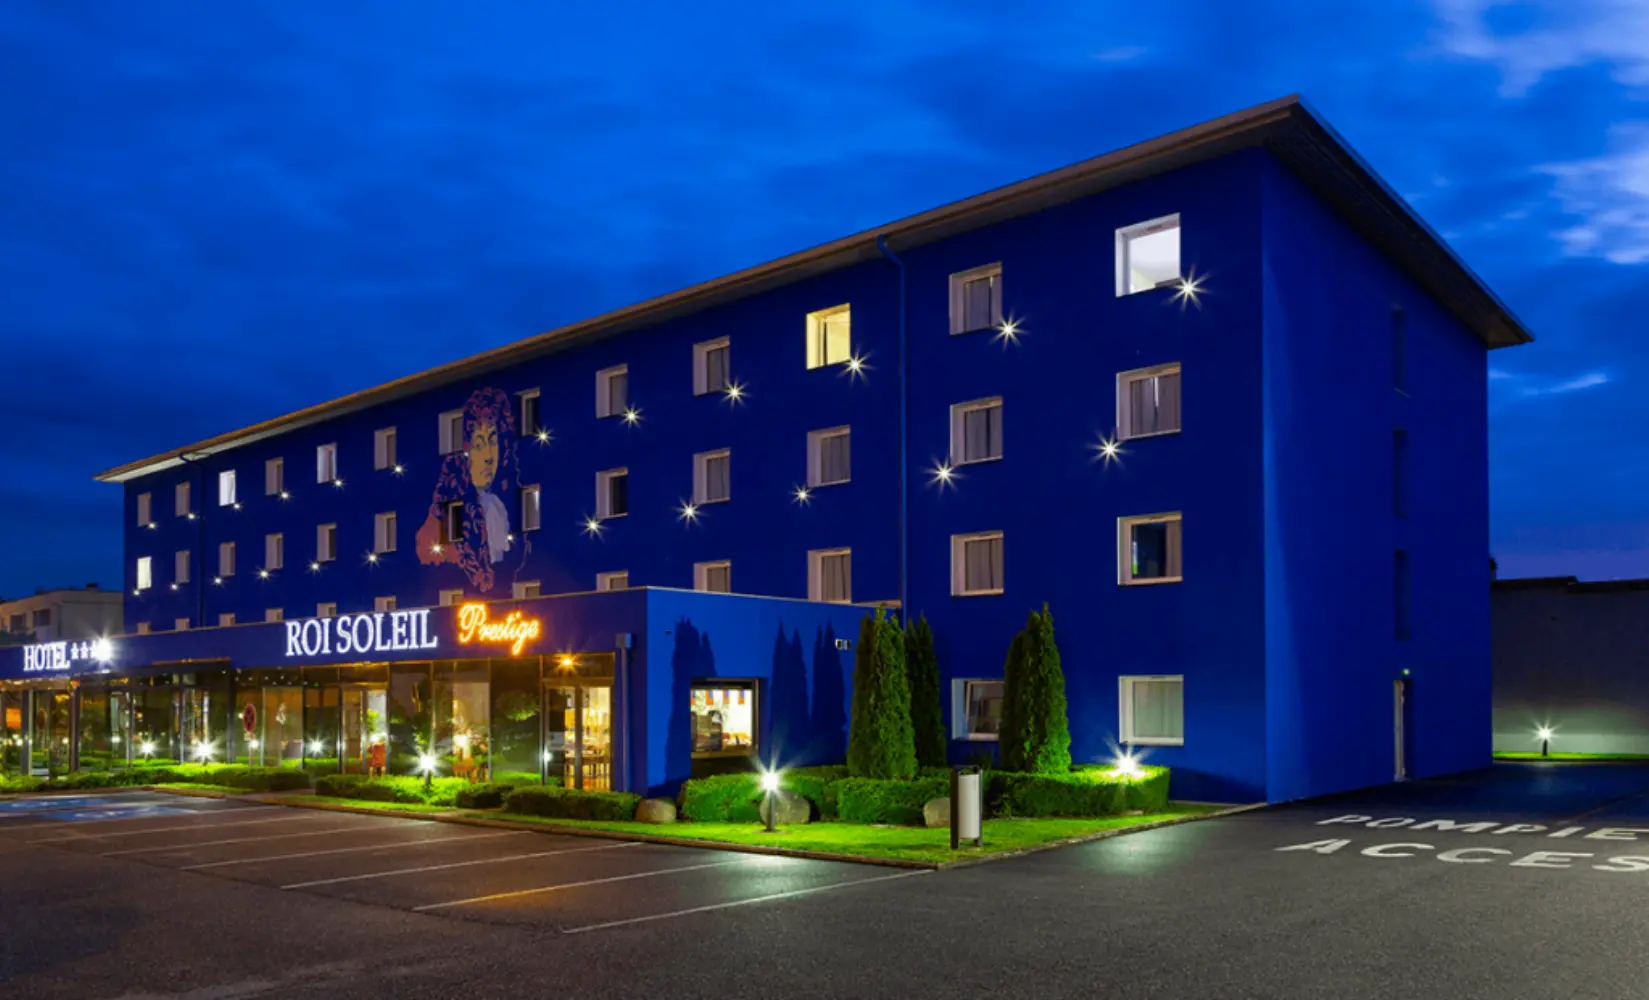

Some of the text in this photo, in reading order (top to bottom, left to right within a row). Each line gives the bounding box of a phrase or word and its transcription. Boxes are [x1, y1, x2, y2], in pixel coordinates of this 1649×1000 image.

[286, 603, 540, 656] ROI SOLEIL Prestige
[23, 642, 70, 671] HOTEL
[1273, 838, 1649, 872] ACCES
